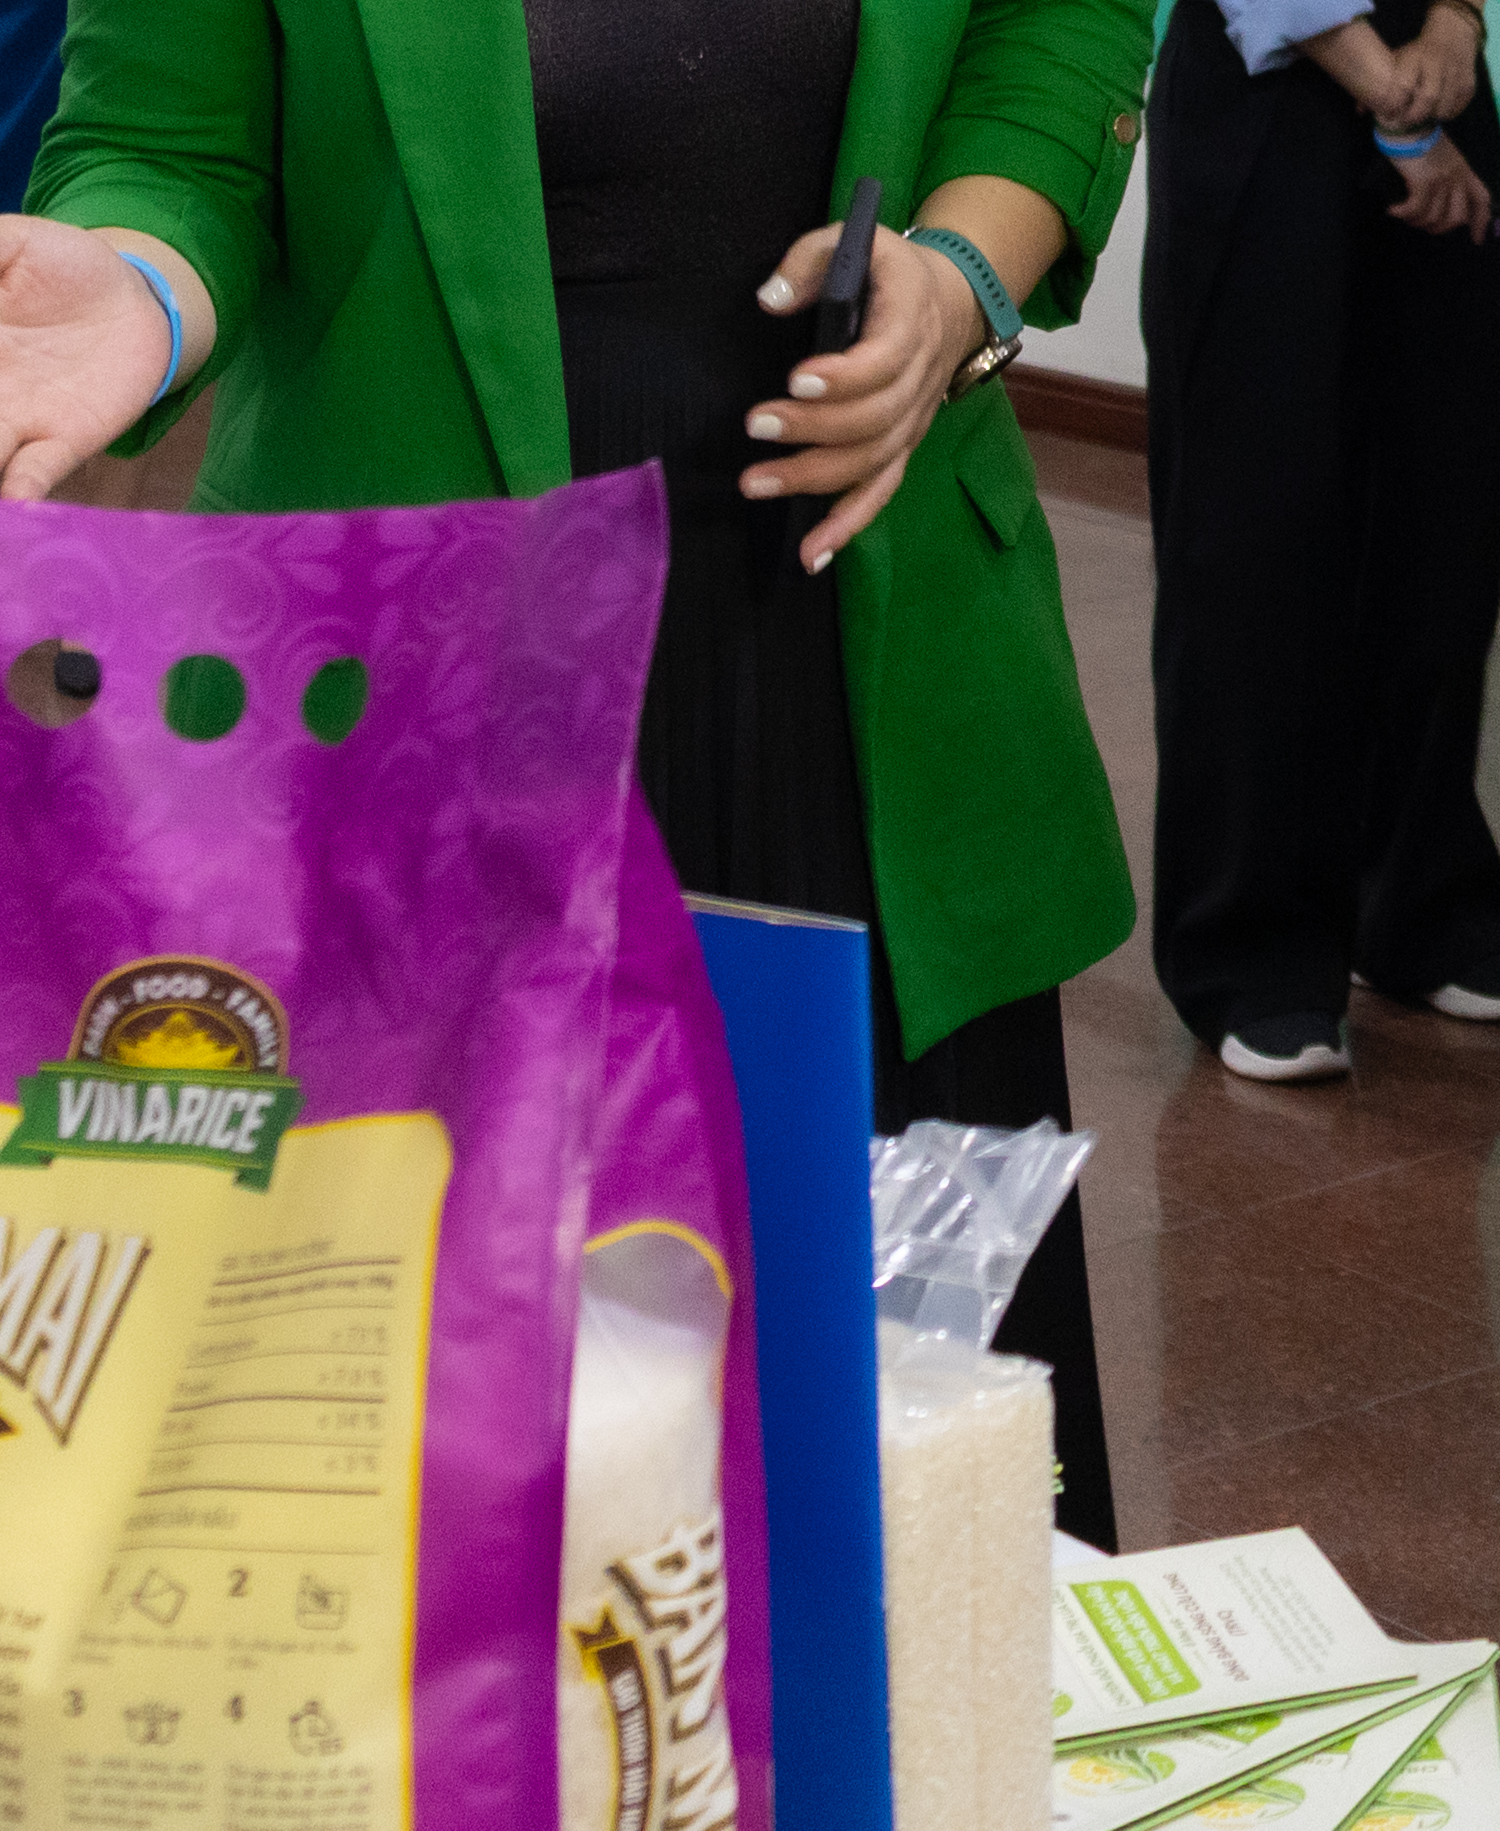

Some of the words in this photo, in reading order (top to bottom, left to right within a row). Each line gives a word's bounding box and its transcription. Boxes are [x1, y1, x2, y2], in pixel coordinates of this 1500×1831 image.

[133, 974, 210, 1003] FOOD
[225, 988, 277, 1066] FAMILY
[57, 1077, 275, 1155] VINARICE
[228, 1569, 250, 1598] 2
